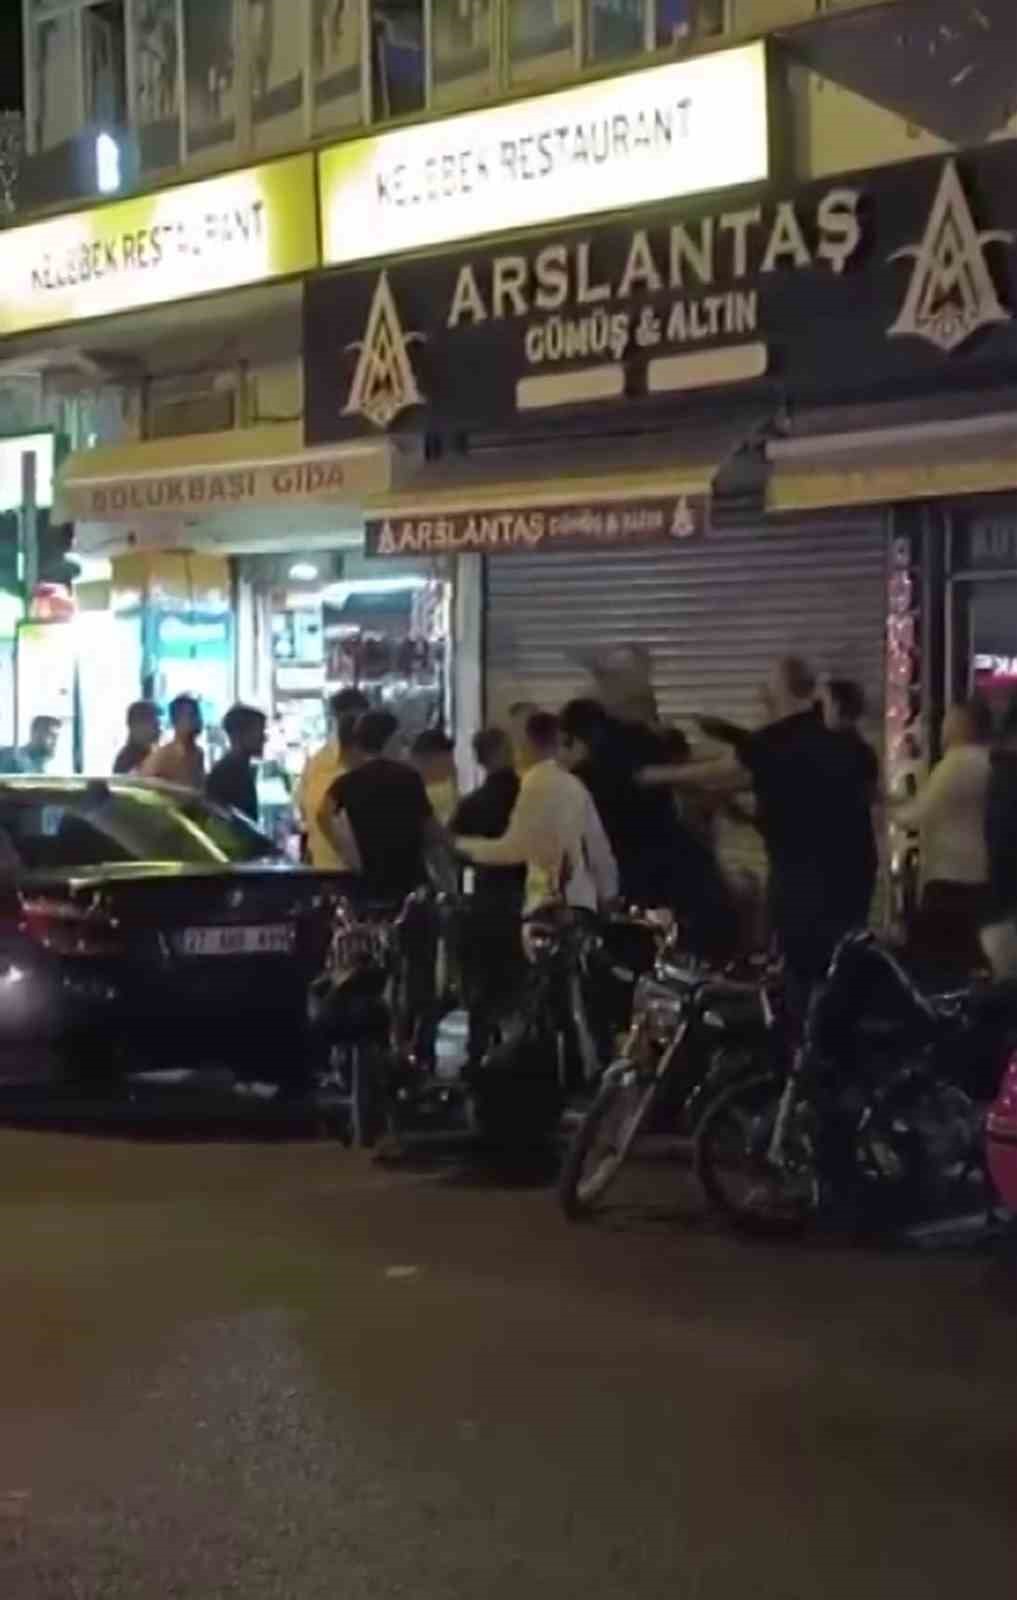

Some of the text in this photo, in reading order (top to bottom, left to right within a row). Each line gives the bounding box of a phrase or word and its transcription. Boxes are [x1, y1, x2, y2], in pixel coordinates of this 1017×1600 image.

[499, 97, 693, 181] RESTAURANT
[447, 189, 862, 329] ARSLANTAŞ
[525, 291, 758, 363] GÜMÜŞ & ALTIN
[401, 512, 545, 548] ARSLANTAŞ
